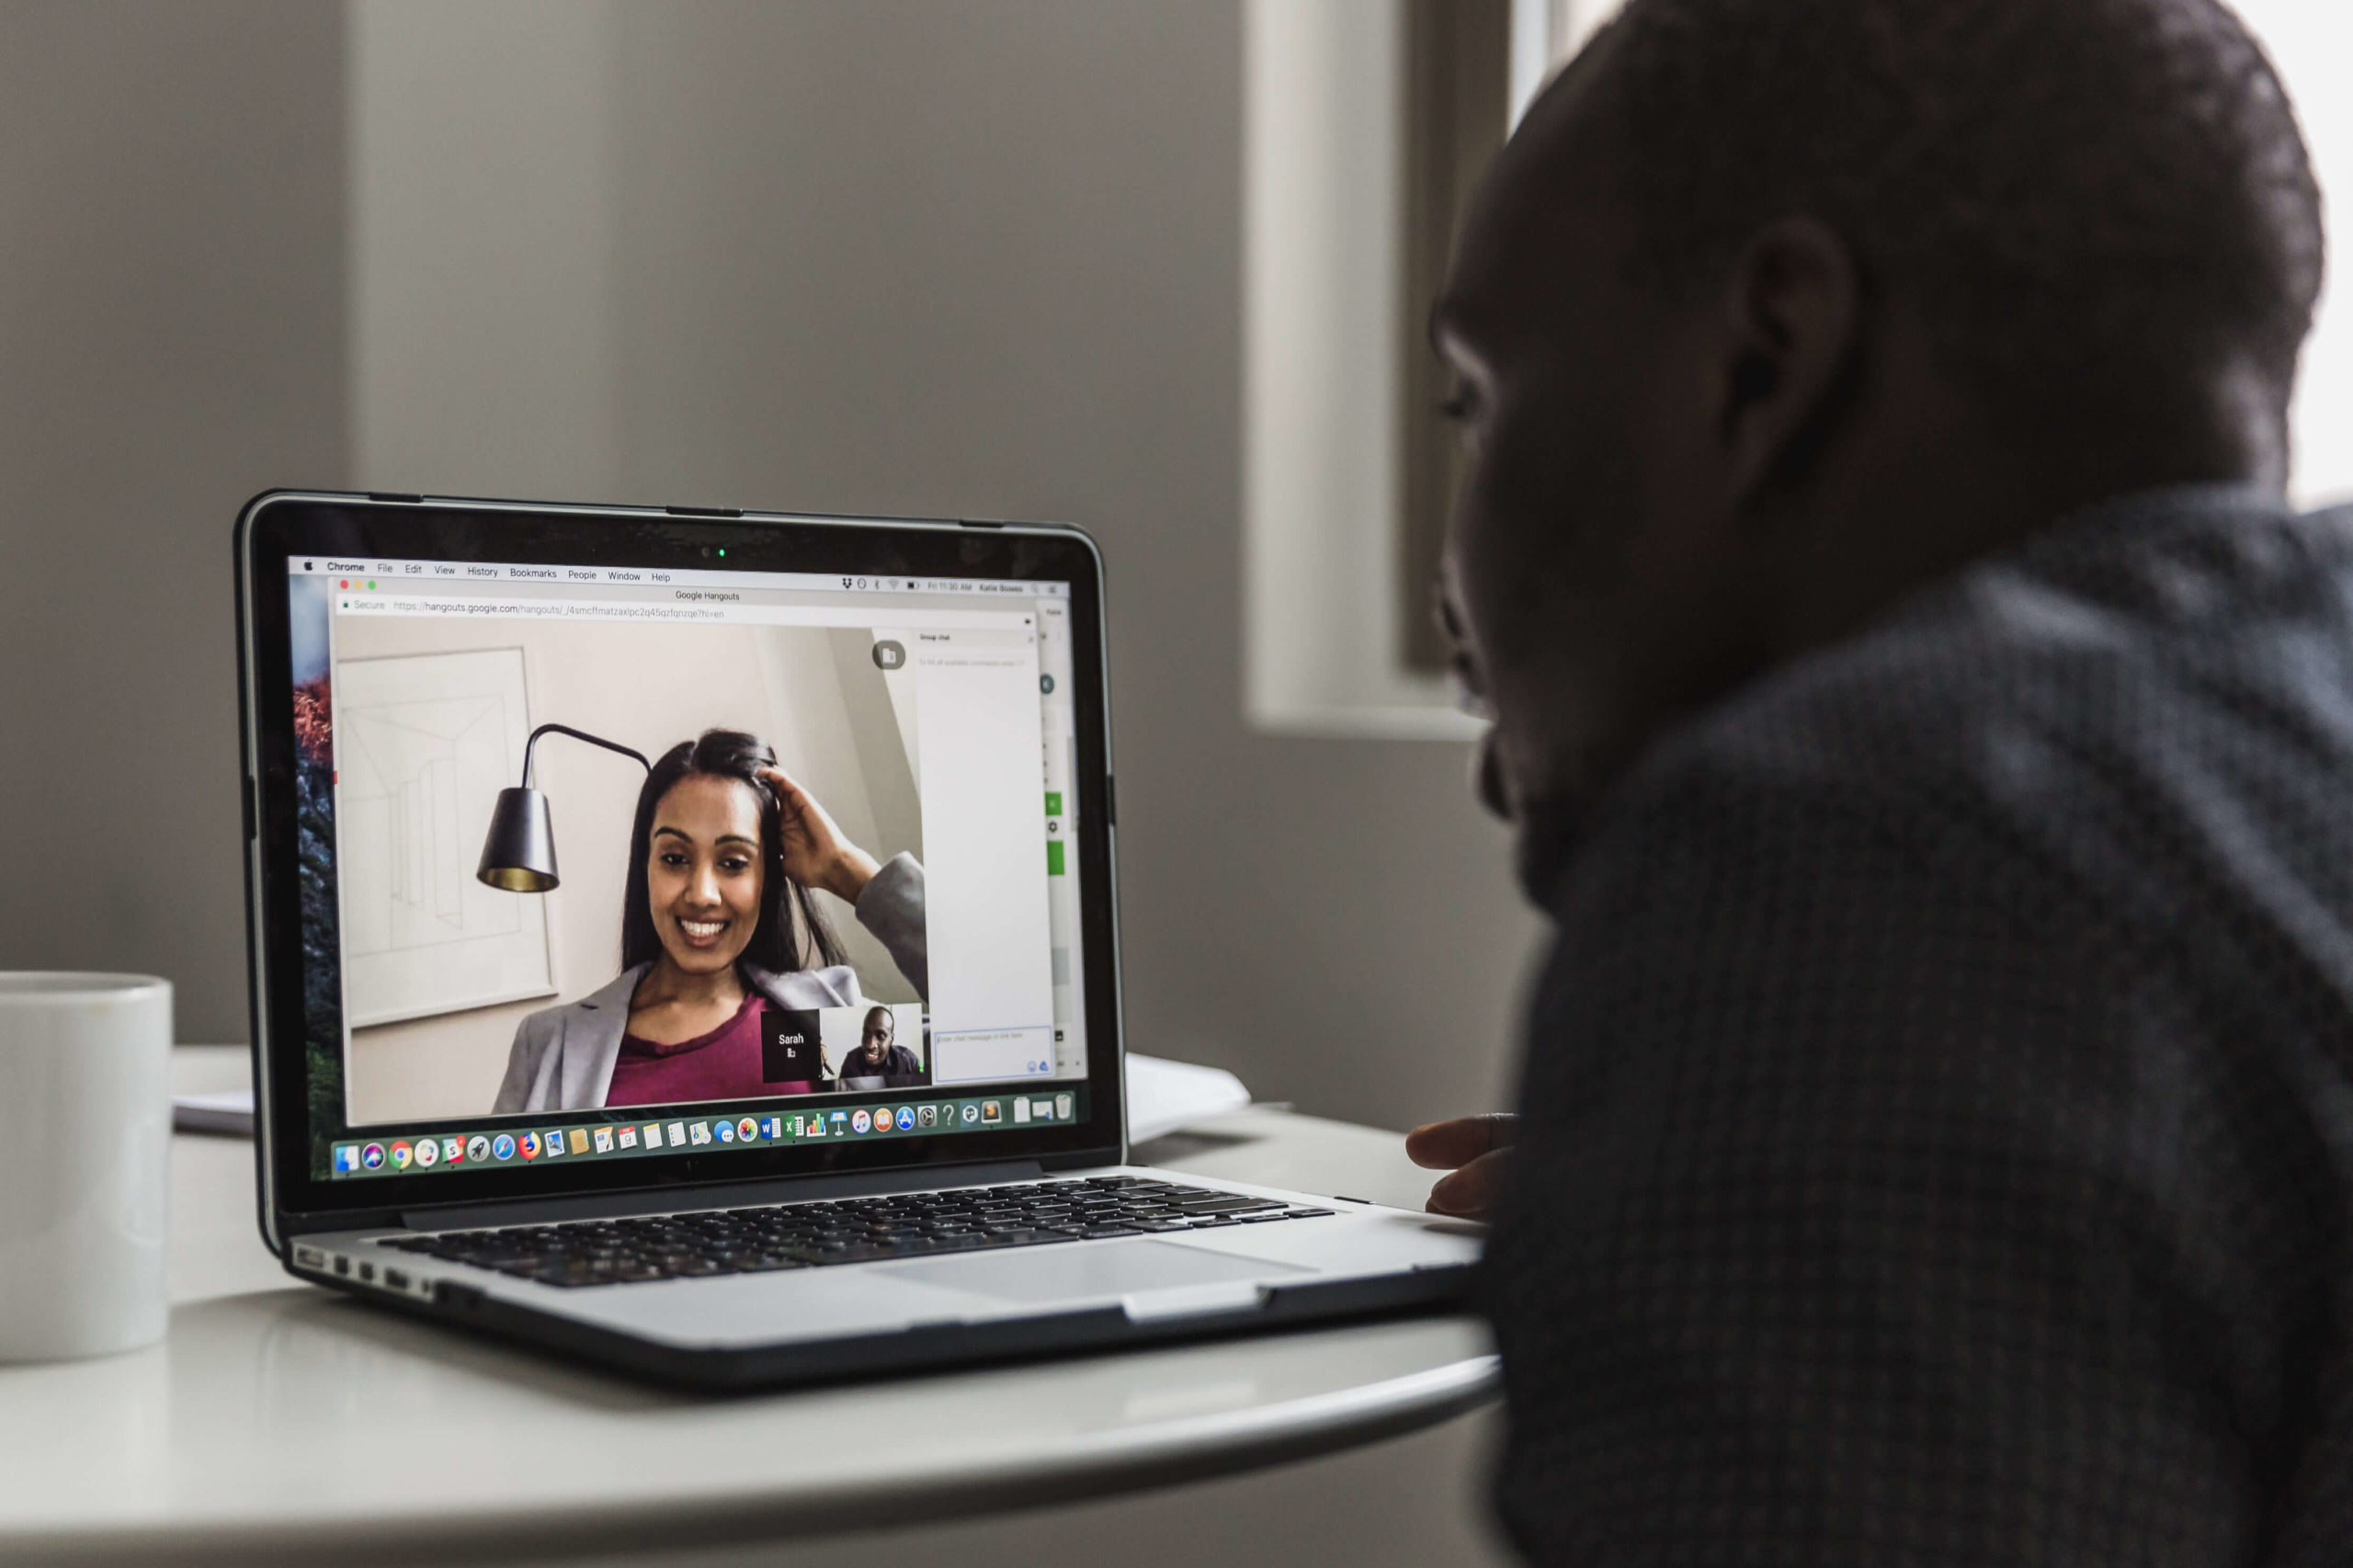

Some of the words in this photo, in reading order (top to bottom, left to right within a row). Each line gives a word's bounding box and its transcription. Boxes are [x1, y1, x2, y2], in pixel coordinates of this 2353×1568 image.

[327, 562, 365, 572] Chrome
[378, 563, 393, 573] File
[405, 564, 422, 574] Edit
[434, 566, 455, 574] View
[468, 567, 498, 578] History
[510, 568, 557, 578] Bookmarks
[568, 570, 597, 582] People
[608, 571, 641, 581] Window
[652, 573, 671, 583] Help
[676, 590, 702, 600] Google
[705, 591, 740, 602] Hangouts
[354, 599, 385, 609] Secure
[779, 1032, 804, 1045] Sarah
[625, 1134, 631, 1144] 9
